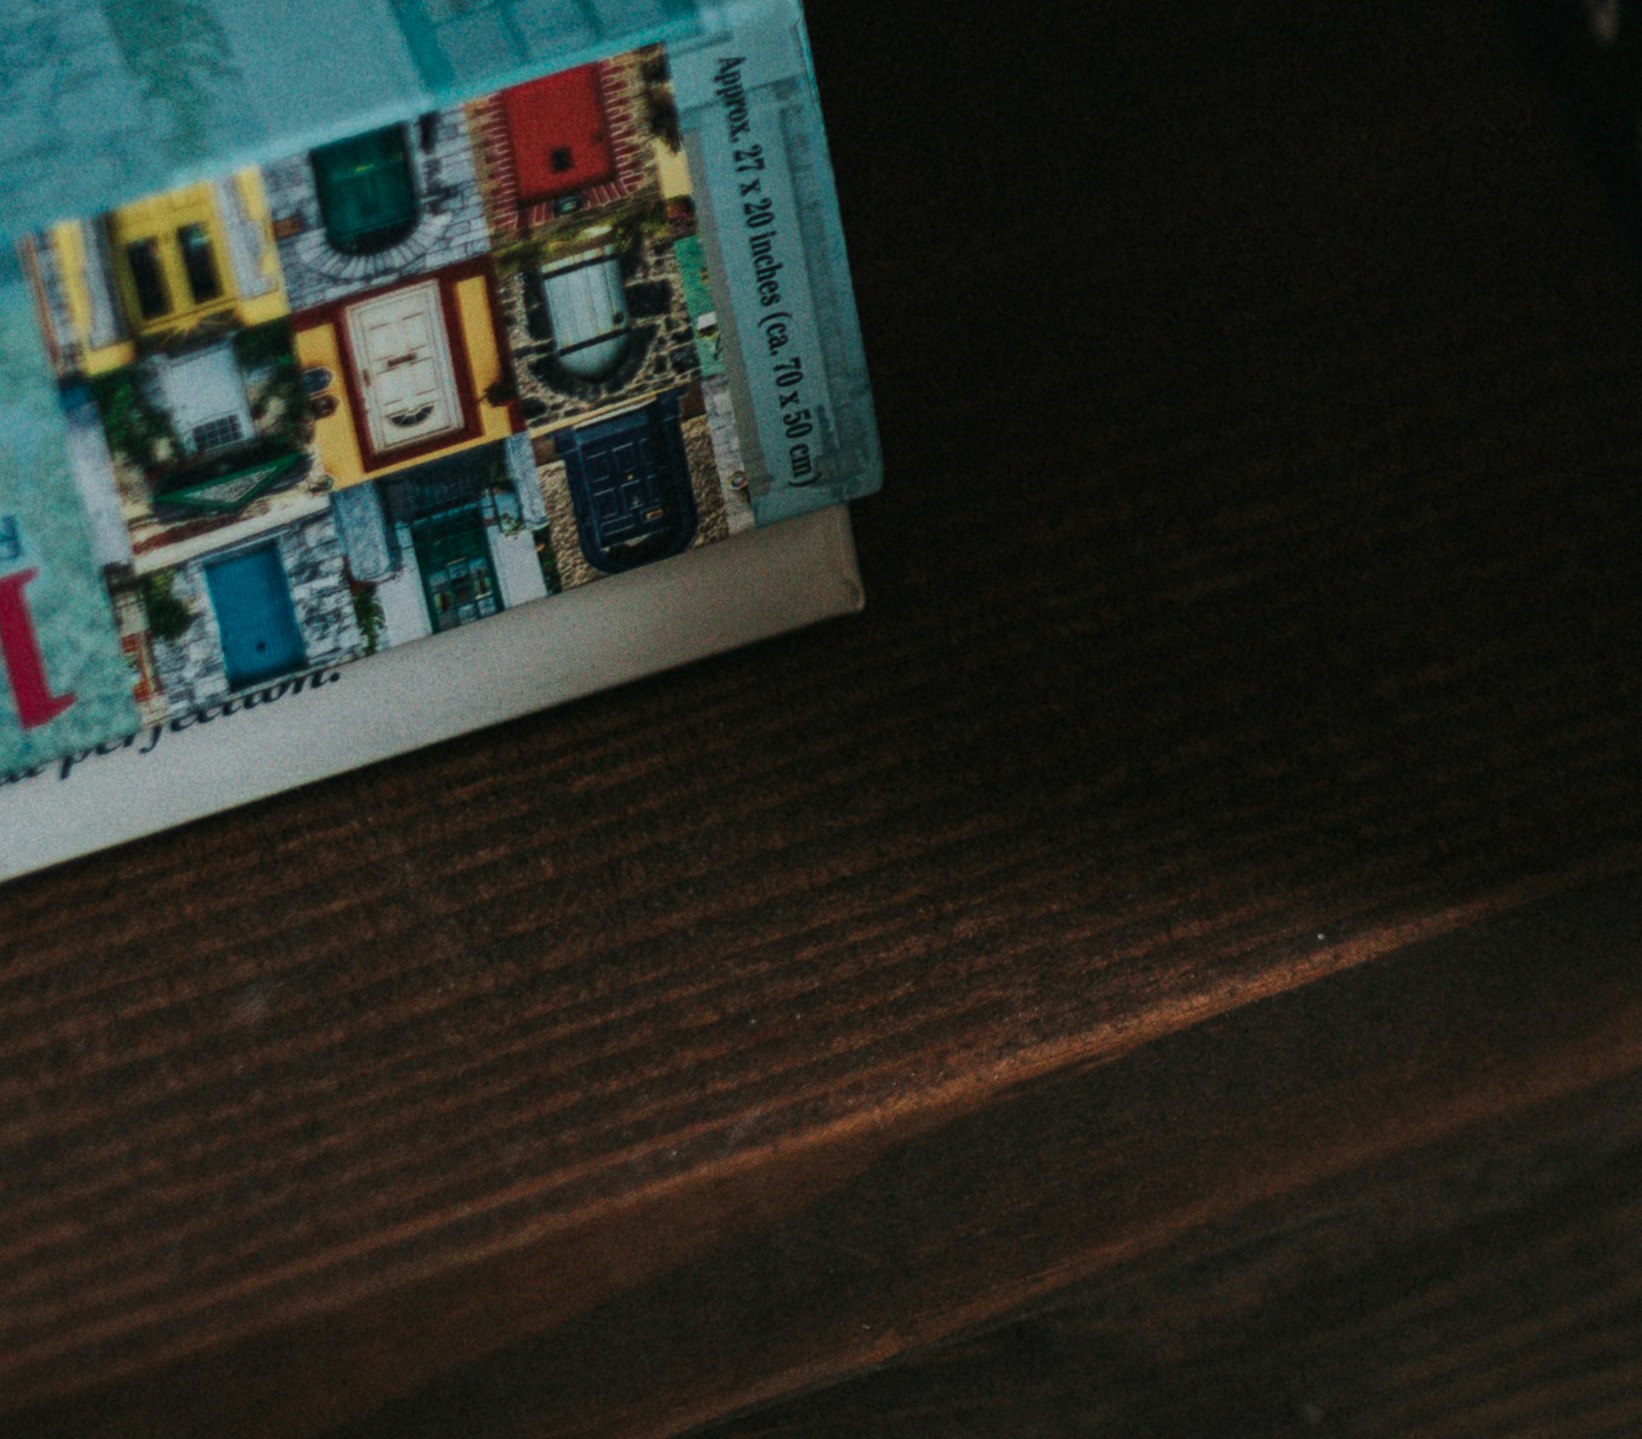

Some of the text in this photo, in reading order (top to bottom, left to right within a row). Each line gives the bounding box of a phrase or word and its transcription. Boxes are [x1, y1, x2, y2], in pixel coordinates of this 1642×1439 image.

[714, 57, 822, 488] Approx. 27 x 20 inches (ca. 70 x 50 cm)
